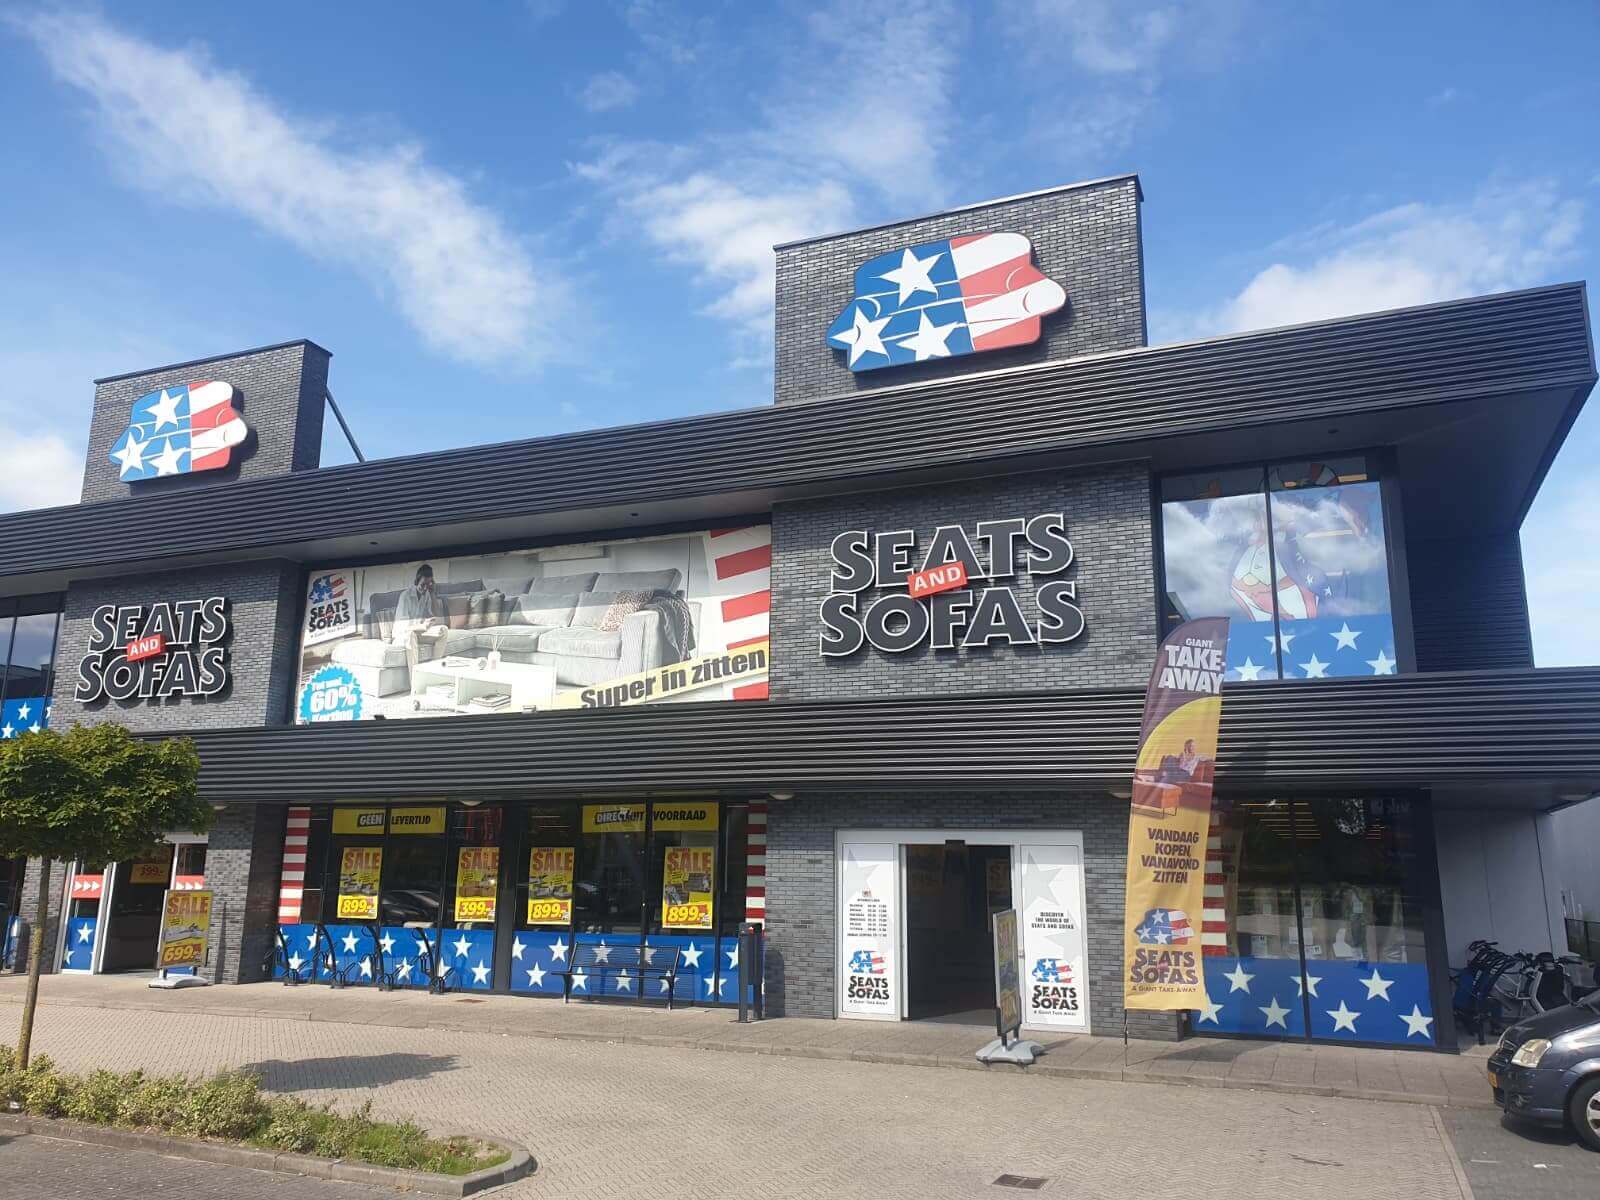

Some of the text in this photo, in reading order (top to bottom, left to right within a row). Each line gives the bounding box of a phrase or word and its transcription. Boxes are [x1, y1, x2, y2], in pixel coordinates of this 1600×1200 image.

[830, 513, 1073, 593] SEATS
[914, 567, 961, 591] AND
[310, 599, 348, 619] SEATS
[819, 581, 1085, 656] SOFAS
[88, 597, 226, 653] SEATS
[308, 611, 350, 633] SOFAS
[130, 638, 159, 657] AND
[1185, 638, 1214, 648] GIANT
[74, 647, 226, 703] SOFAS
[581, 649, 765, 708] Super in zitten
[1158, 667, 1224, 694] AWAY
[310, 686, 357, 713] 60%
[360, 815, 431, 825] GEEN LEVERTIJD
[654, 810, 706, 821] VOORRAAD
[1147, 827, 1199, 843] VANDAAG
[344, 852, 380, 870] SALE
[461, 852, 498, 870] SALE
[532, 852, 573, 871] SALE
[667, 852, 712, 871] SALE
[1141, 855, 1200, 870] VANAVOND
[1152, 870, 1188, 884] ZITTEN
[167, 896, 209, 914] SALE
[1135, 948, 1195, 968] SEATS
[849, 975, 888, 988] SEATS
[1130, 965, 1198, 985] SOFAS
[847, 985, 889, 1000] SOFAS
[1033, 985, 1077, 998] SEATS
[1031, 996, 1079, 1010] SOFAS
